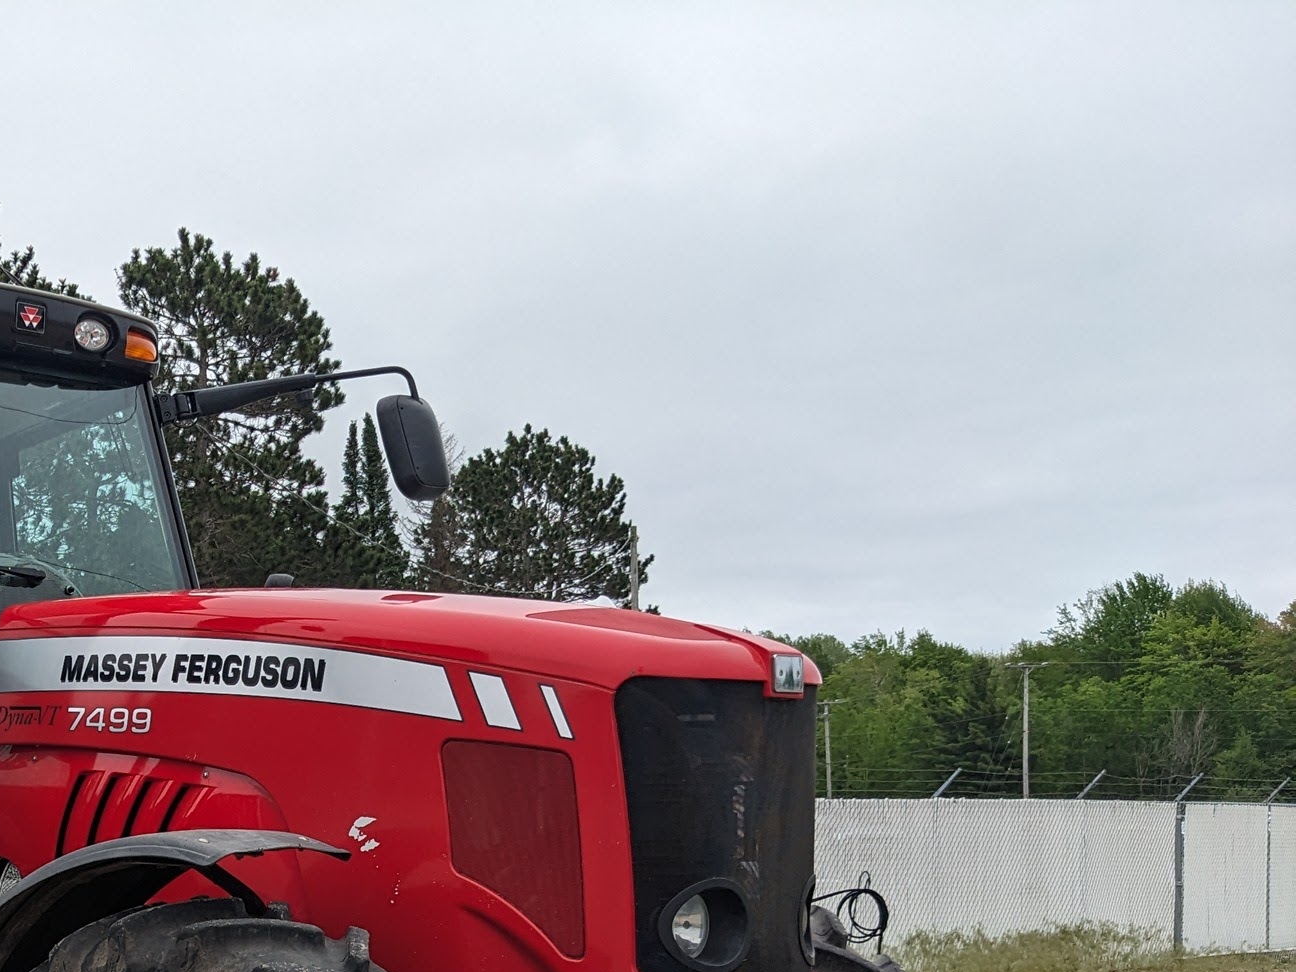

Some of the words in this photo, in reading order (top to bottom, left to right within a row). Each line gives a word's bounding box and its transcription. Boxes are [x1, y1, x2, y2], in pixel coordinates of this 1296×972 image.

[60, 653, 167, 683] MASSEY
[171, 654, 326, 692] FERGUSON
[67, 706, 152, 734] 7499
